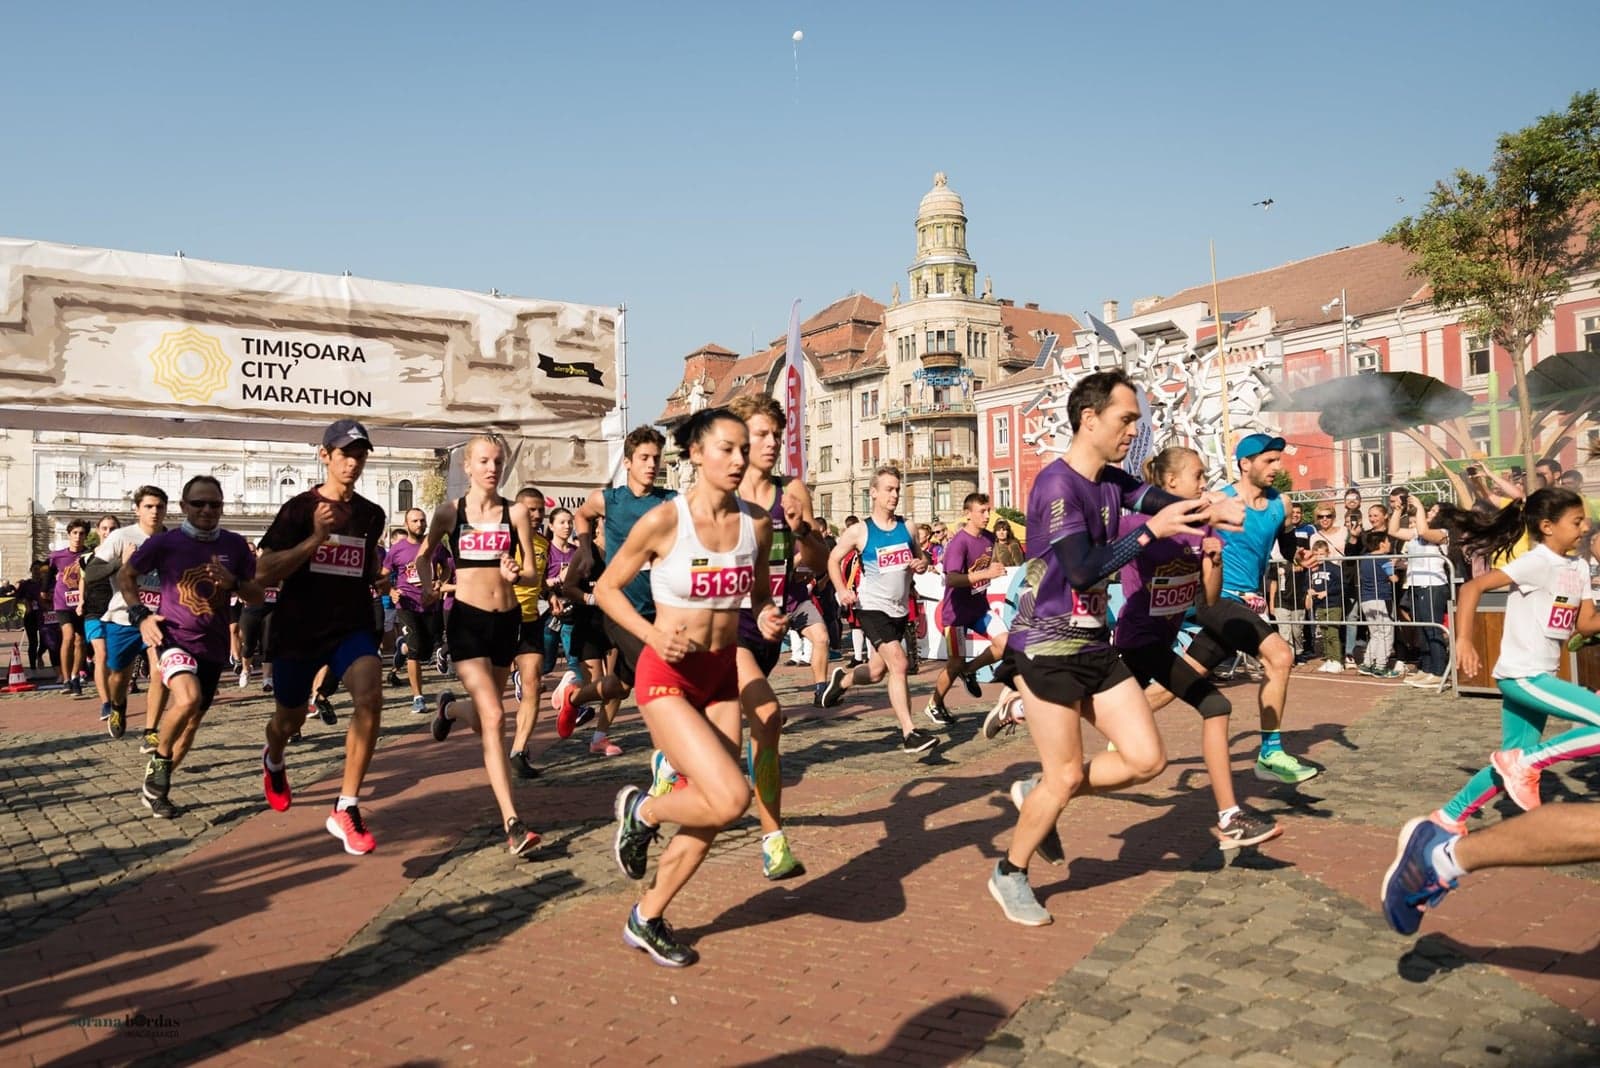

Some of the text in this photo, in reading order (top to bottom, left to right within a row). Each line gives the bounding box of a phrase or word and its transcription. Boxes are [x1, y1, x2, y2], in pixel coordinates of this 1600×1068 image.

[241, 384, 372, 408] MARATHON
[464, 533, 507, 550] 5147
[315, 545, 361, 567] 5148
[880, 550, 910, 567] 5216
[695, 570, 751, 597] 5130
[1155, 584, 1194, 607] 5050
[649, 685, 684, 697] IRO
